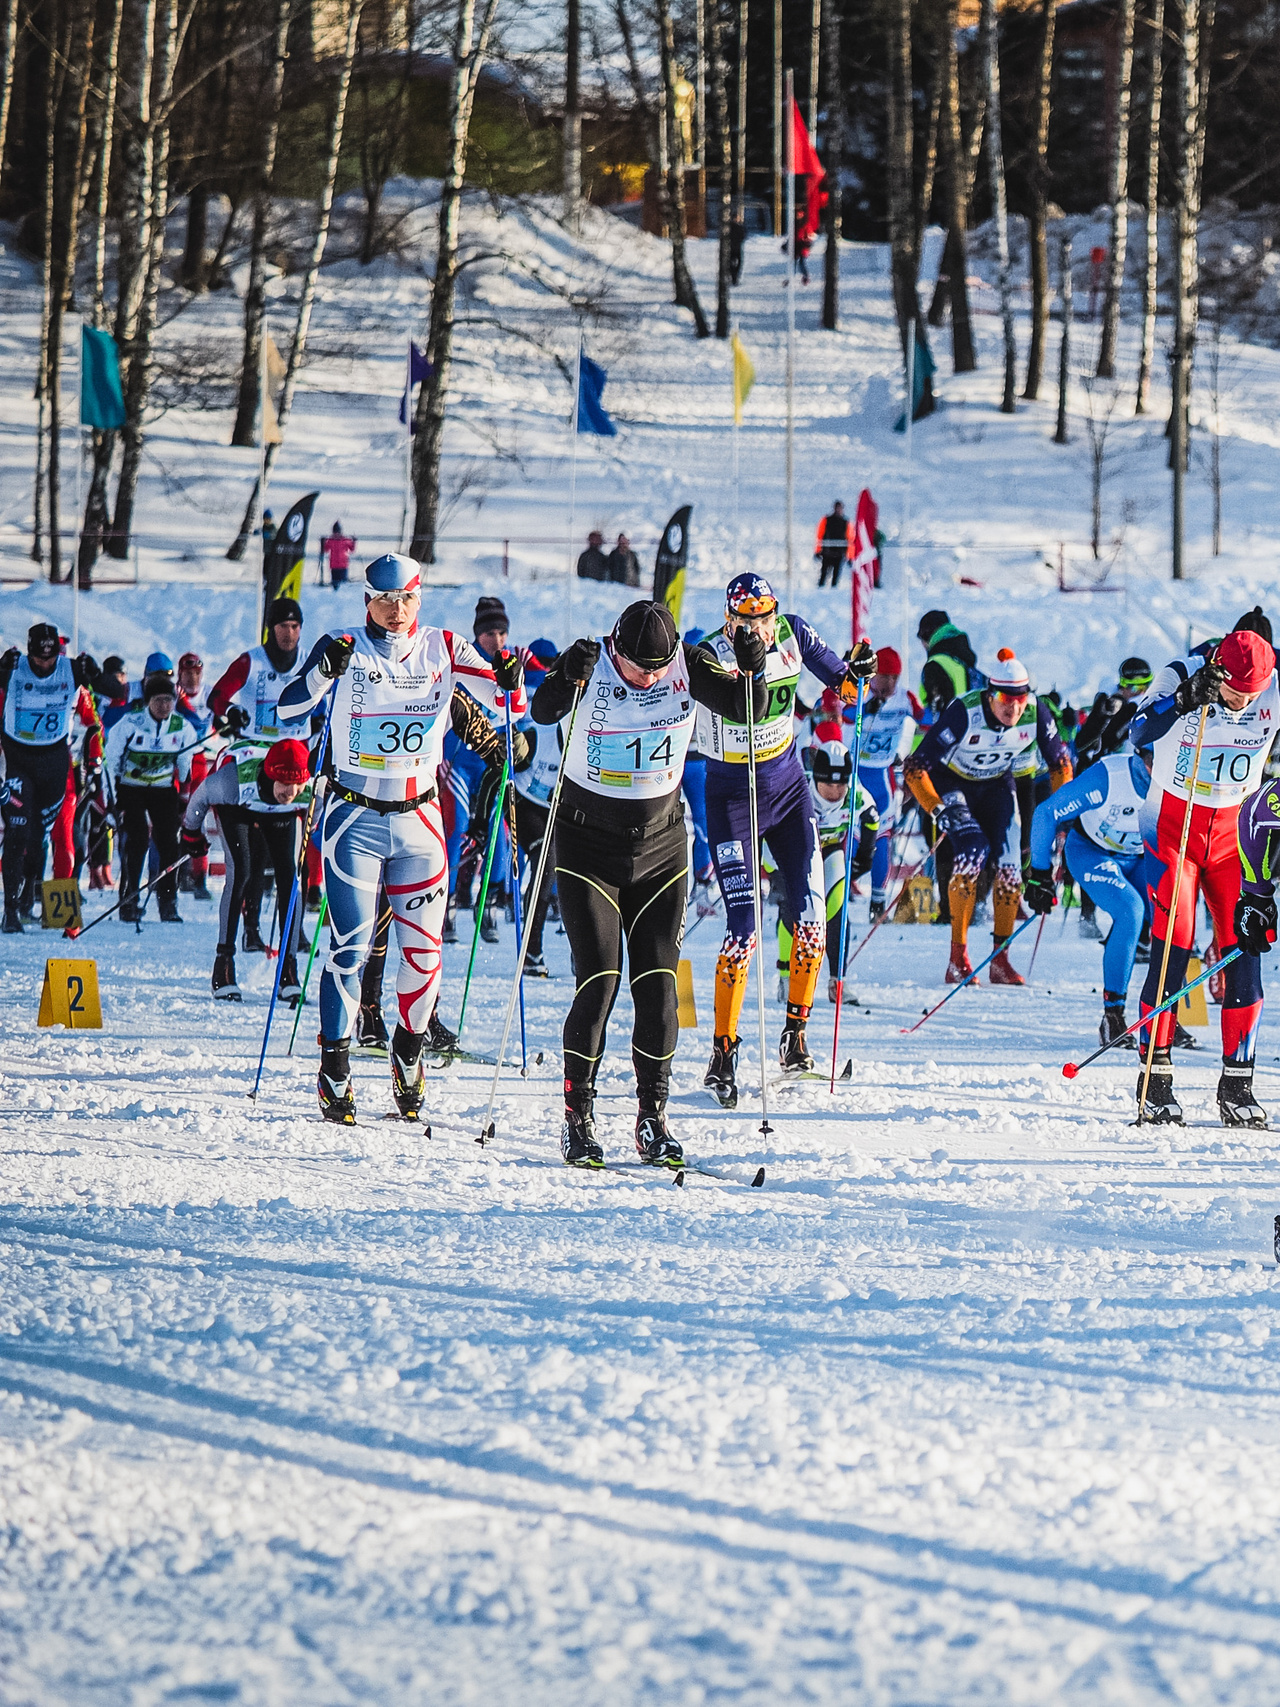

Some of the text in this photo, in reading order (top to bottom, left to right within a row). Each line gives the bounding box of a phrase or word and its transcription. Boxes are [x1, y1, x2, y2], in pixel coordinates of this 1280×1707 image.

[347, 666, 367, 767] russialoppet
[405, 703, 438, 712] МОСКВА
[651, 713, 689, 727] МОСКВА
[30, 713, 59, 732] 78
[584, 680, 611, 783] russialoppet
[377, 722, 425, 753] 36
[626, 735, 674, 769] 14
[868, 735, 892, 753] 54
[1173, 705, 1203, 788] russialoppe
[1210, 753, 1250, 782] 10
[1053, 799, 1082, 820] Audi
[50, 891, 78, 918] 24
[67, 976, 85, 1011] 2
